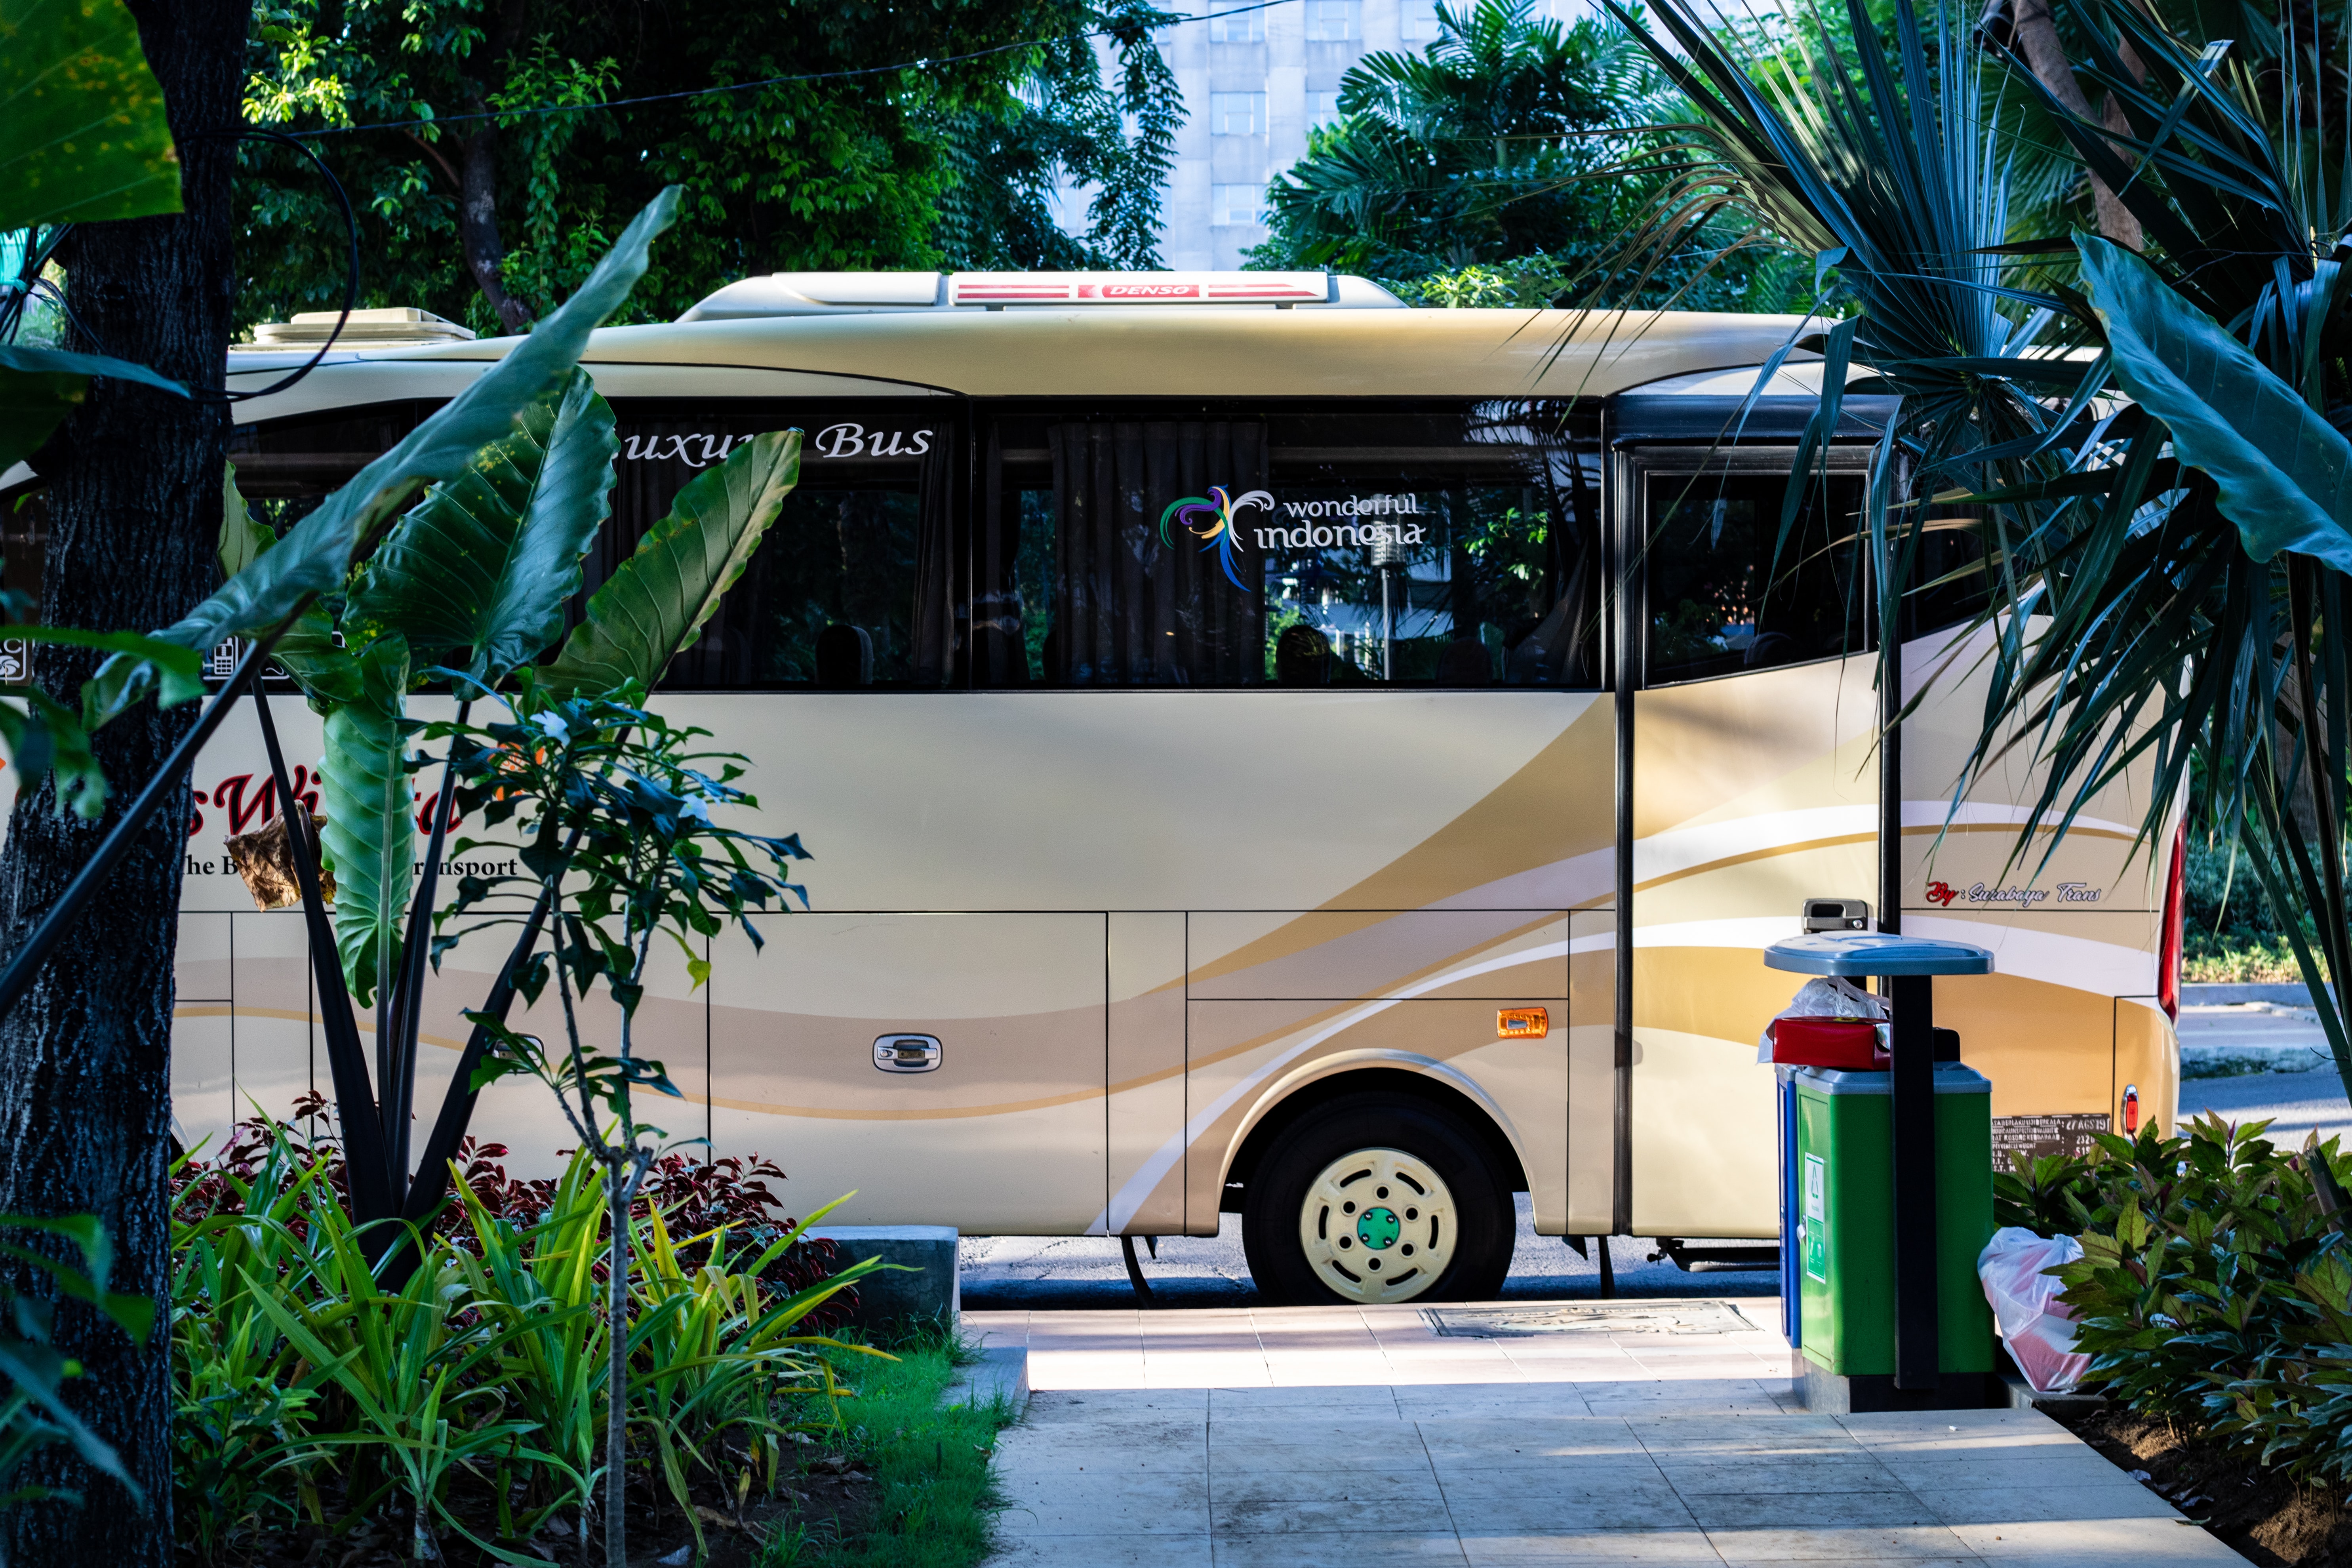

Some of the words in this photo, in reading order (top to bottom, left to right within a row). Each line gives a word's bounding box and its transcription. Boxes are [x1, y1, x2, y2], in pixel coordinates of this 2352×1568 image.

[1110, 286, 1190, 295] DENSO
[815, 423, 933, 458] Bus
[1283, 493, 1419, 517] wonderful
[1253, 520, 1426, 549] indonesia
[184, 854, 215, 875] he
[413, 858, 517, 876] rnsport
[1968, 882, 2050, 908] Surabaya
[2057, 882, 2101, 903] Trans
